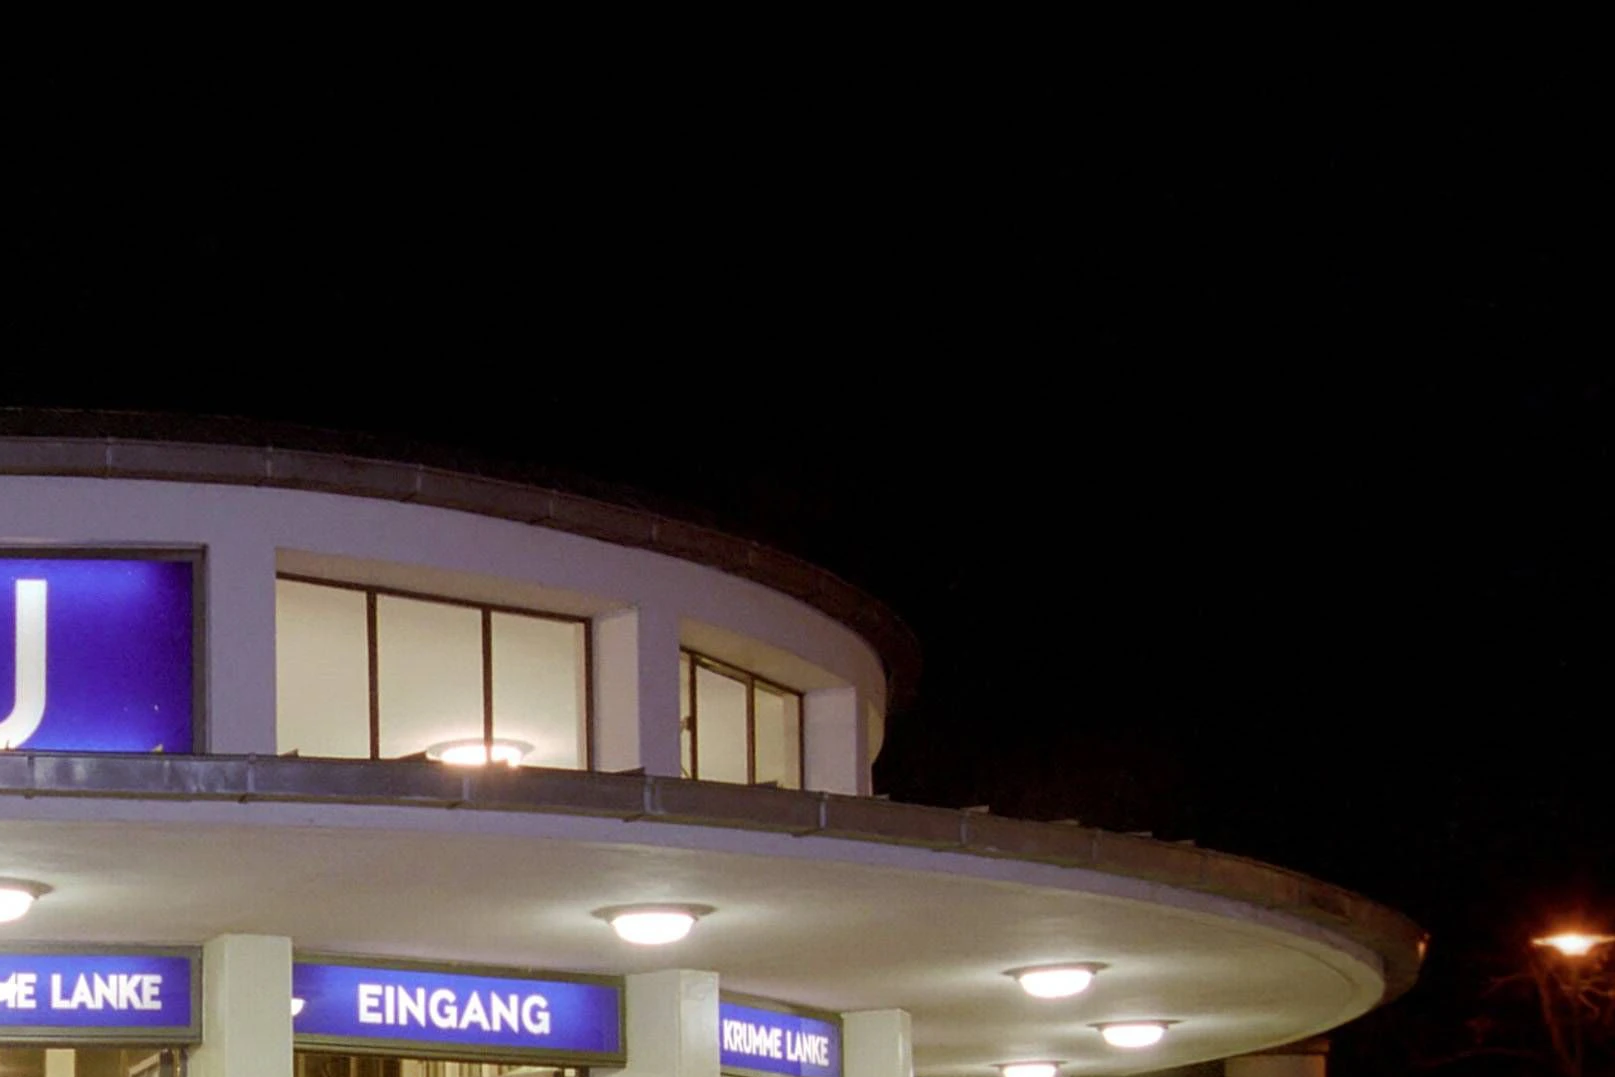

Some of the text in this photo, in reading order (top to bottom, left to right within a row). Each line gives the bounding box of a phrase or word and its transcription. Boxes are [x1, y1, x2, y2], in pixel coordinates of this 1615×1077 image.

[50, 974, 163, 1010] LANKE
[357, 983, 552, 1036] EINGANG
[722, 1018, 830, 1067] KRUMME LANKE
